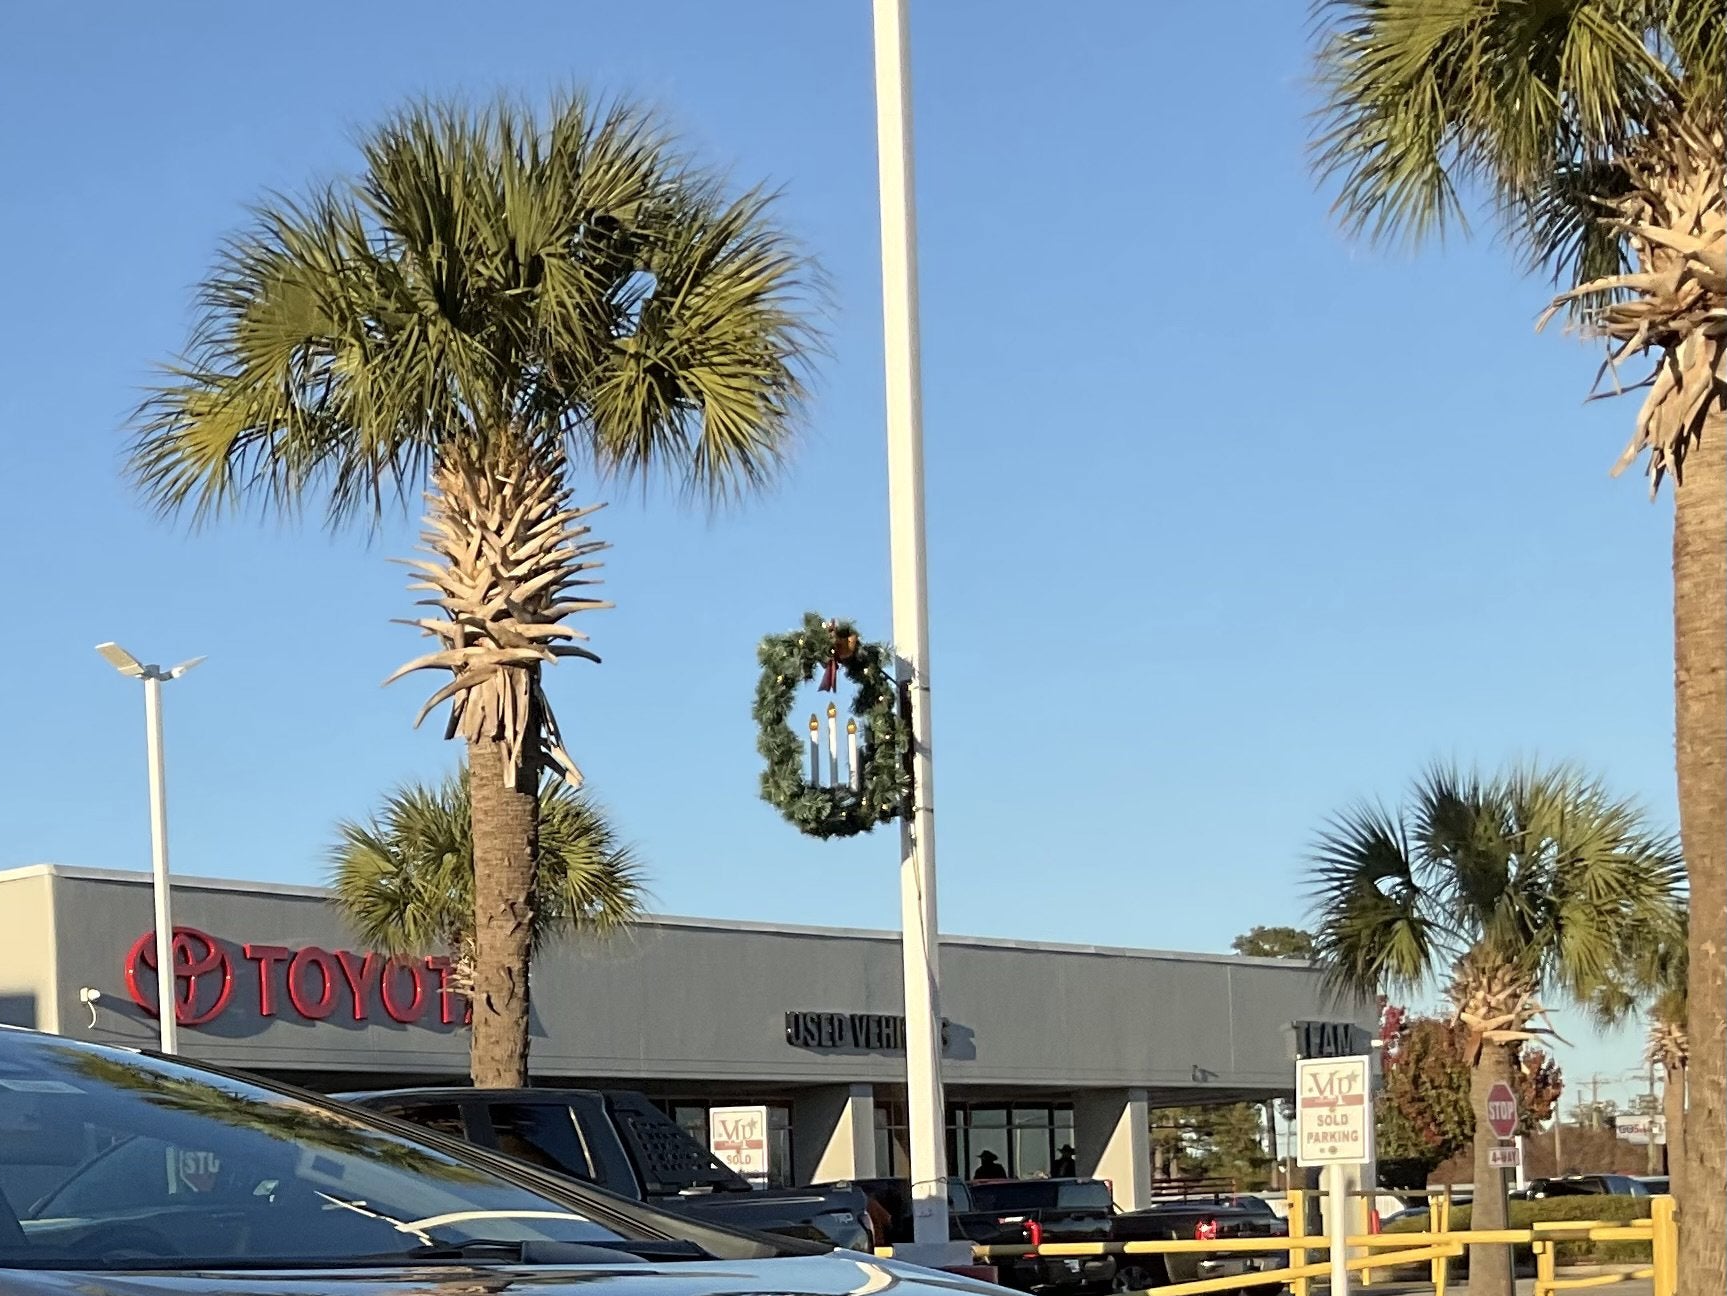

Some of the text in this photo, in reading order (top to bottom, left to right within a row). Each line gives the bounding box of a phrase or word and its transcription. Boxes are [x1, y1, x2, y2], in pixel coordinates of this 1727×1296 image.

[243, 943, 473, 1024] TOYOT
[785, 1011, 850, 1047] USED
[1488, 1100, 1514, 1120] STOP
[1317, 1114, 1349, 1127] SOLD
[1307, 1130, 1359, 1144] PARKING
[727, 1154, 752, 1165] SOLD
